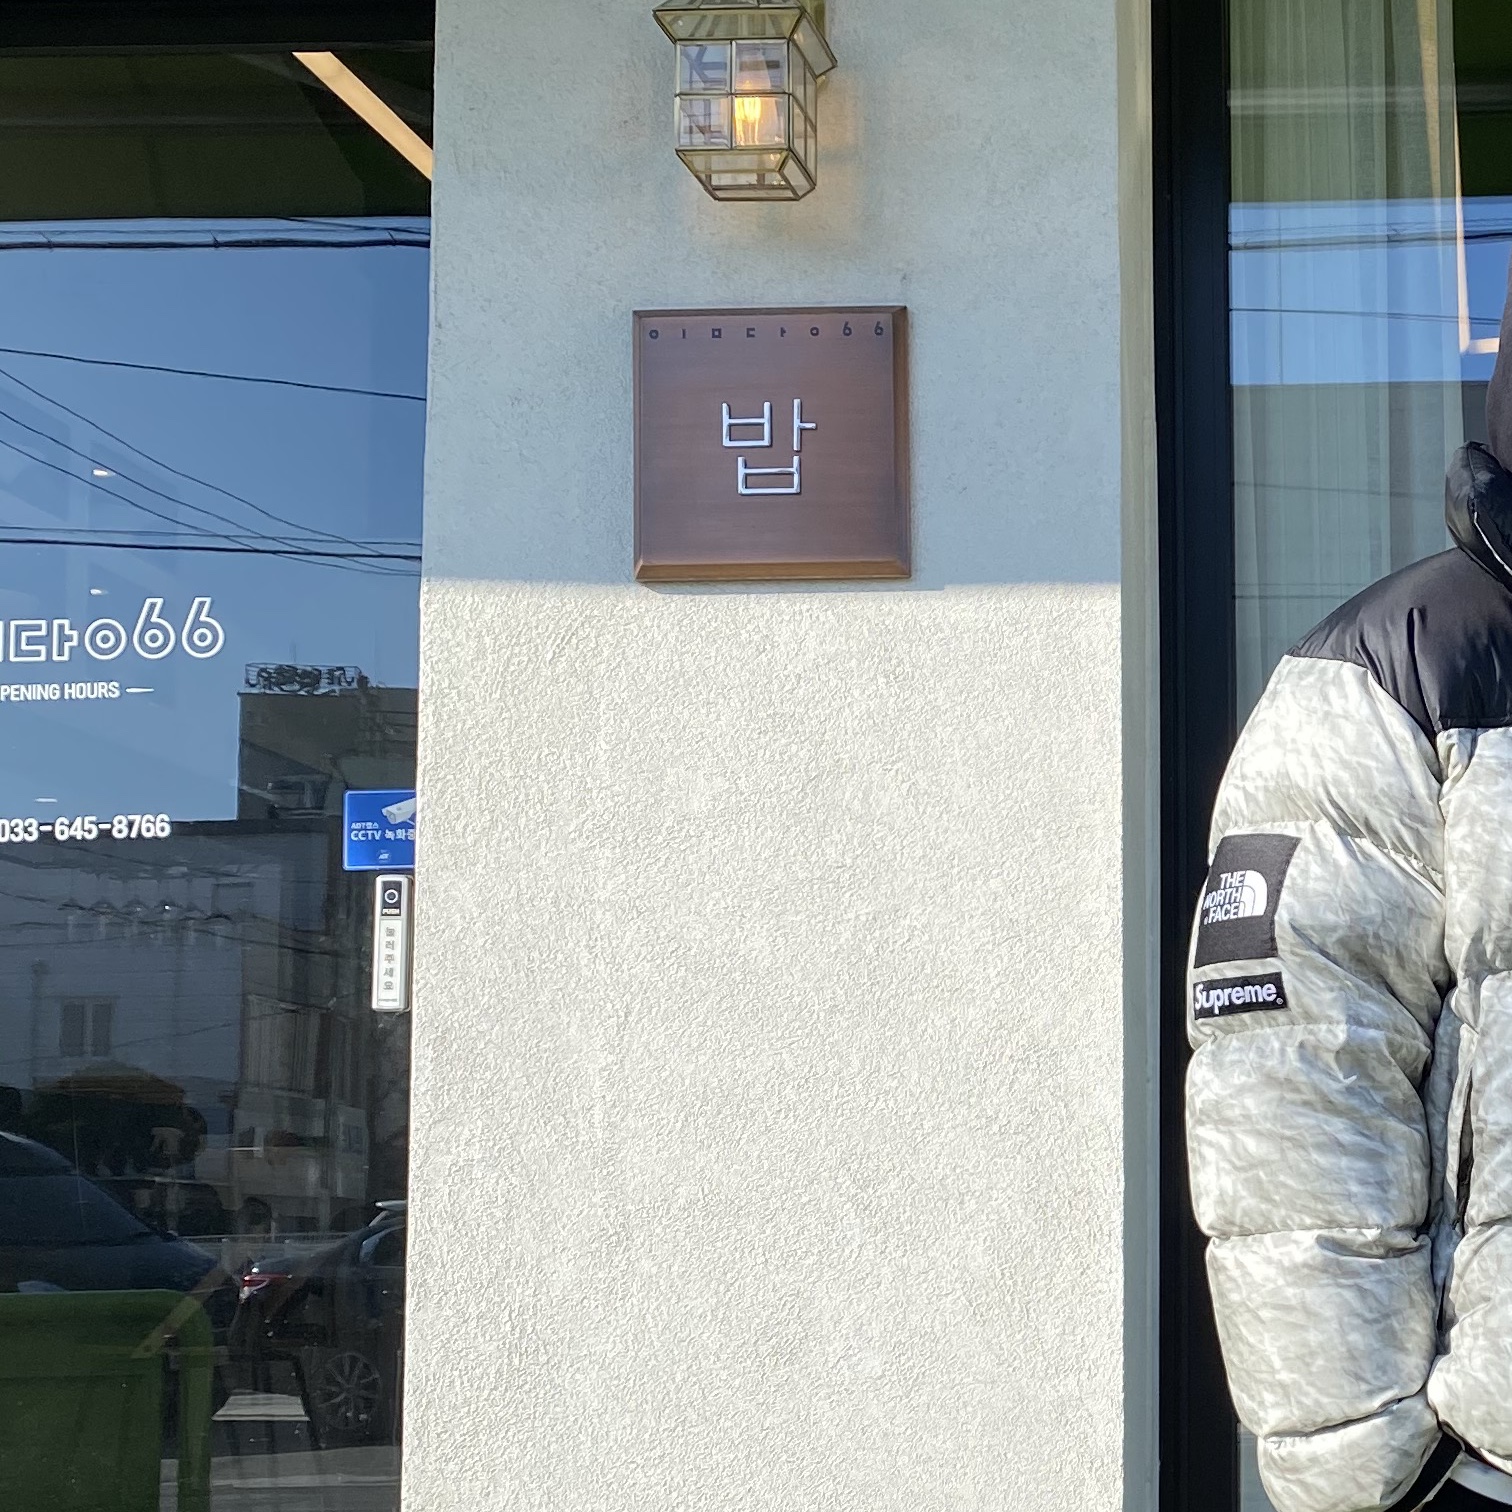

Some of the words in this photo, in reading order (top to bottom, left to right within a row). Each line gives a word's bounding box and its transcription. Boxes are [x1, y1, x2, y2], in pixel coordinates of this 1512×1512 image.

[63, 681, 120, 700] HOURS
[0, 813, 171, 843] 033-645-8766
[350, 829, 382, 841] CCTV
[1219, 870, 1246, 889] THE
[1203, 886, 1243, 911] NORTH
[1208, 902, 1240, 924] FACE
[1194, 982, 1278, 1016] Supreme
